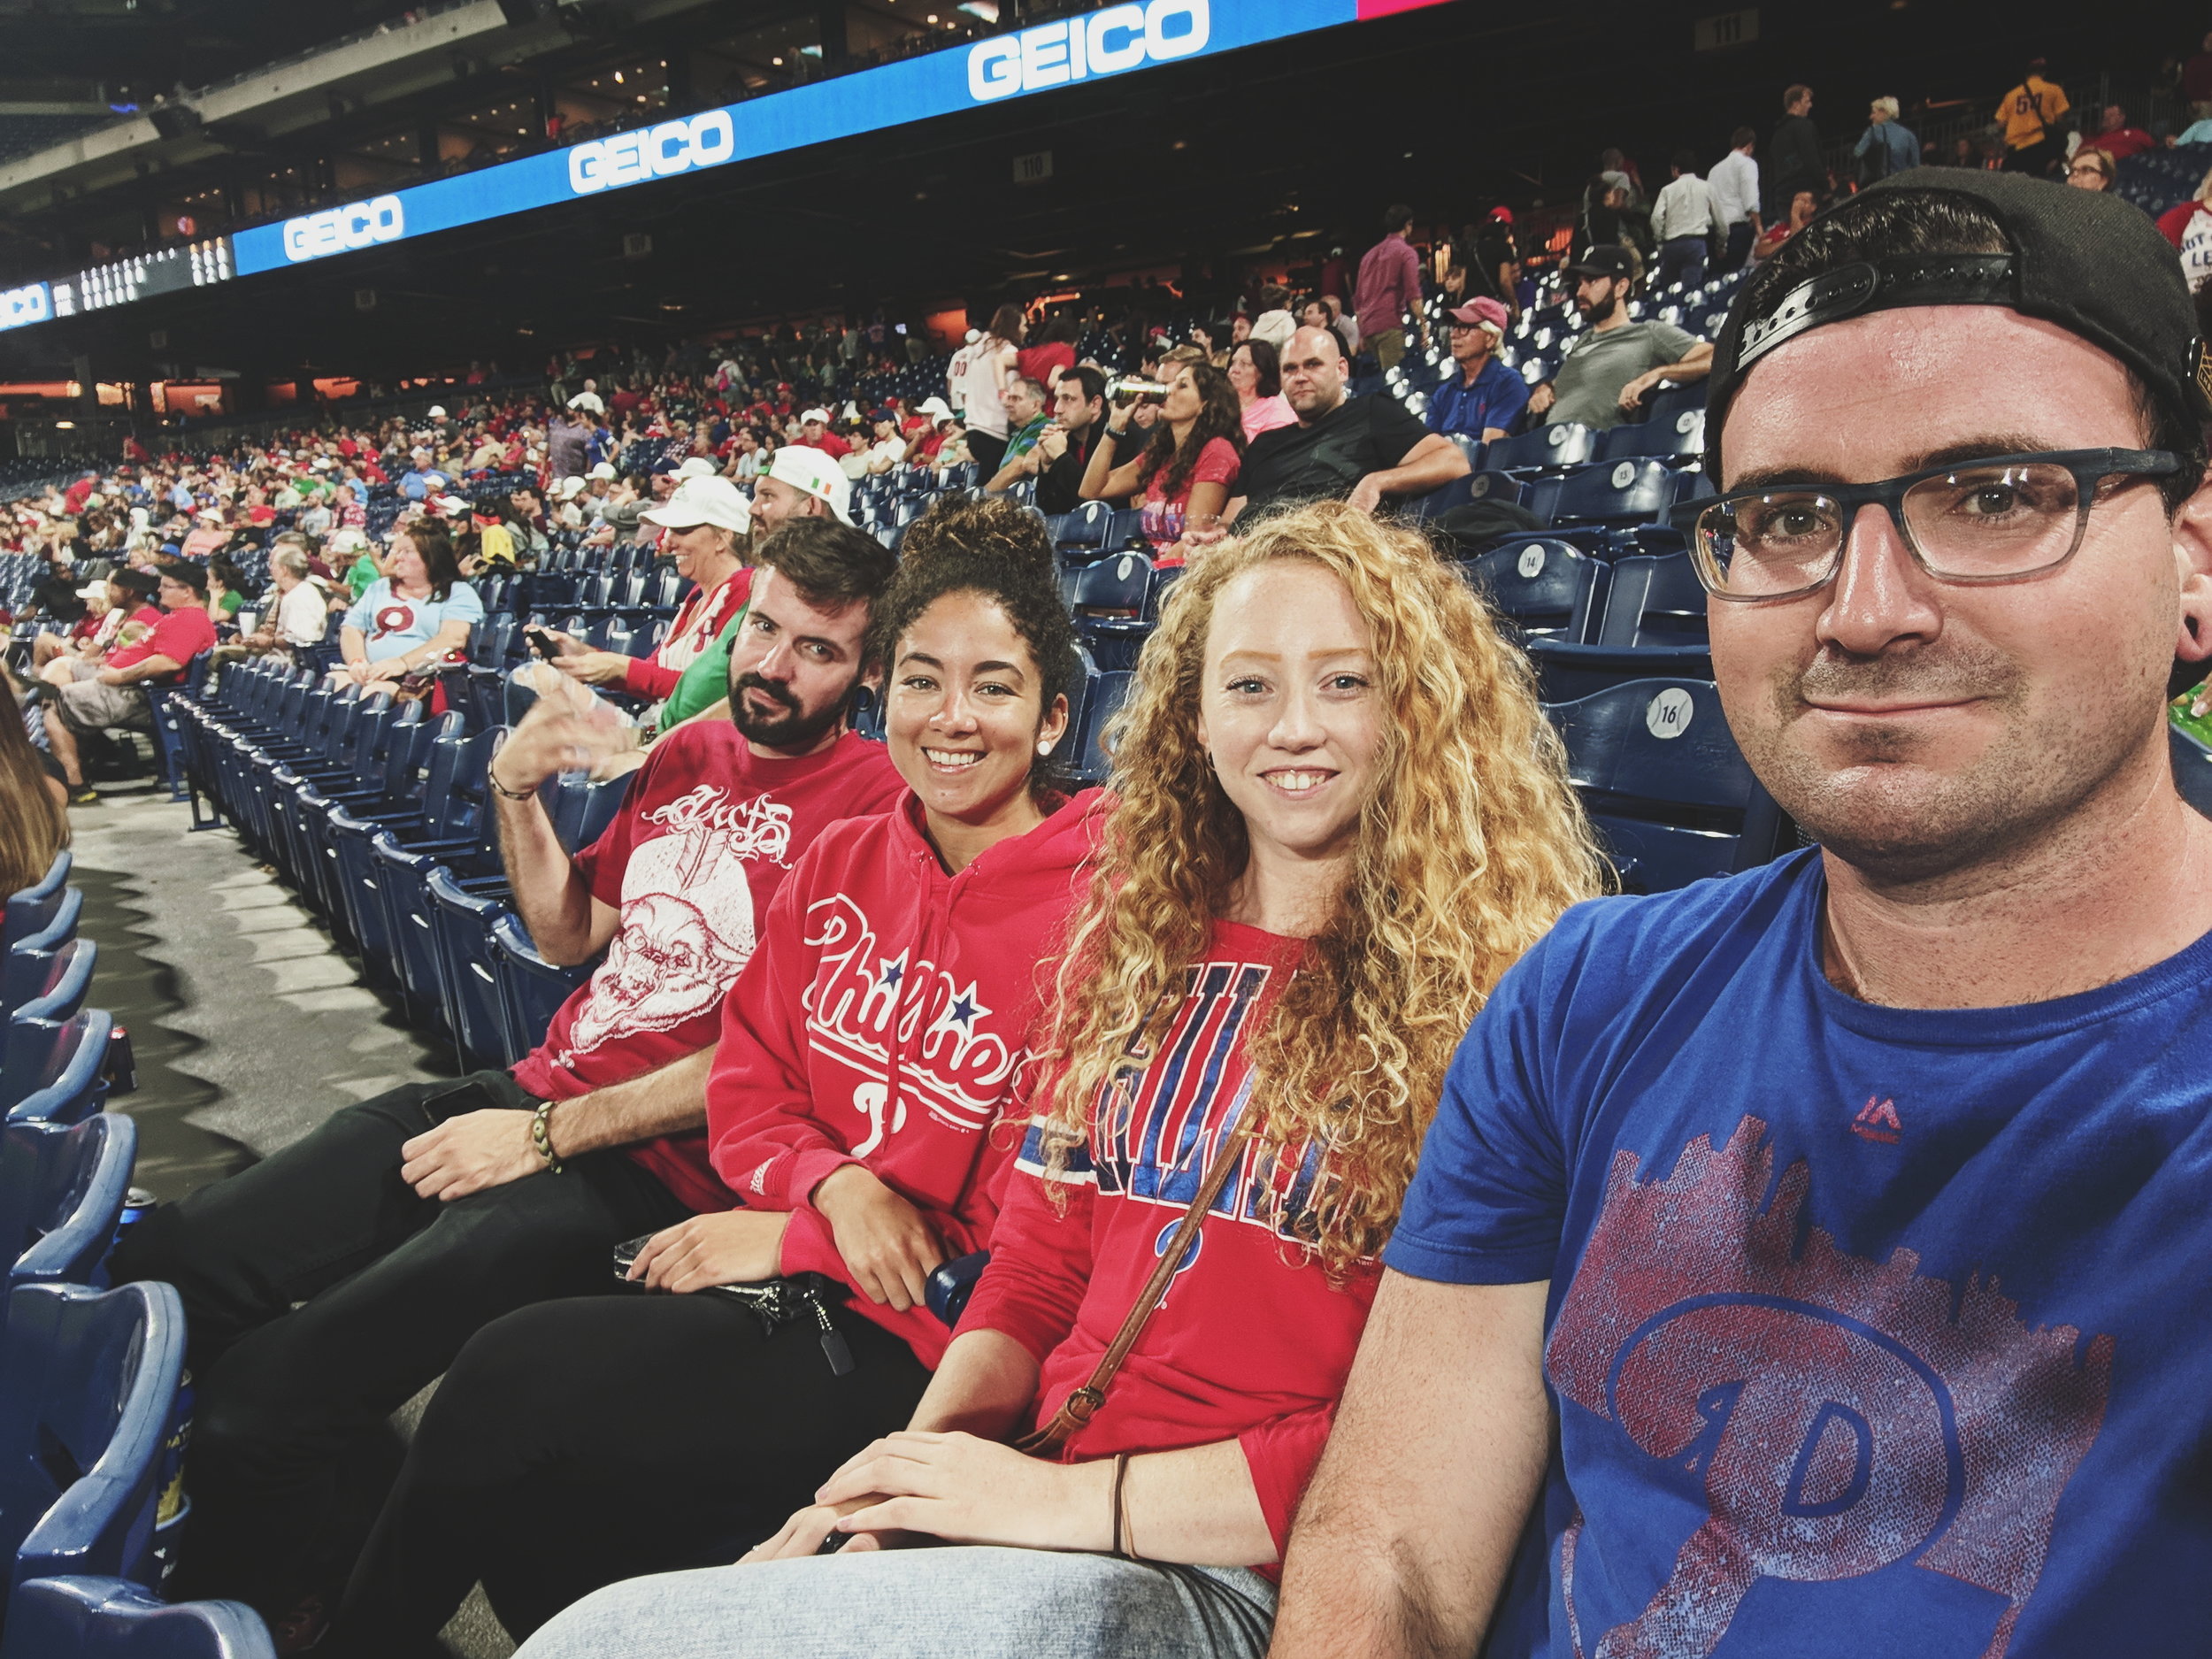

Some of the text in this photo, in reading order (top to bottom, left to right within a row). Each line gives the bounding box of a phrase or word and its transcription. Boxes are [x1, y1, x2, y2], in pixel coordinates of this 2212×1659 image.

[967, 0, 1210, 102] GEICO
[1714, 16, 1740, 44] 111
[569, 110, 733, 194] GEICO
[1023, 155, 1043, 176] 110
[283, 194, 403, 261] GEICO
[1662, 705, 1678, 724] 16
